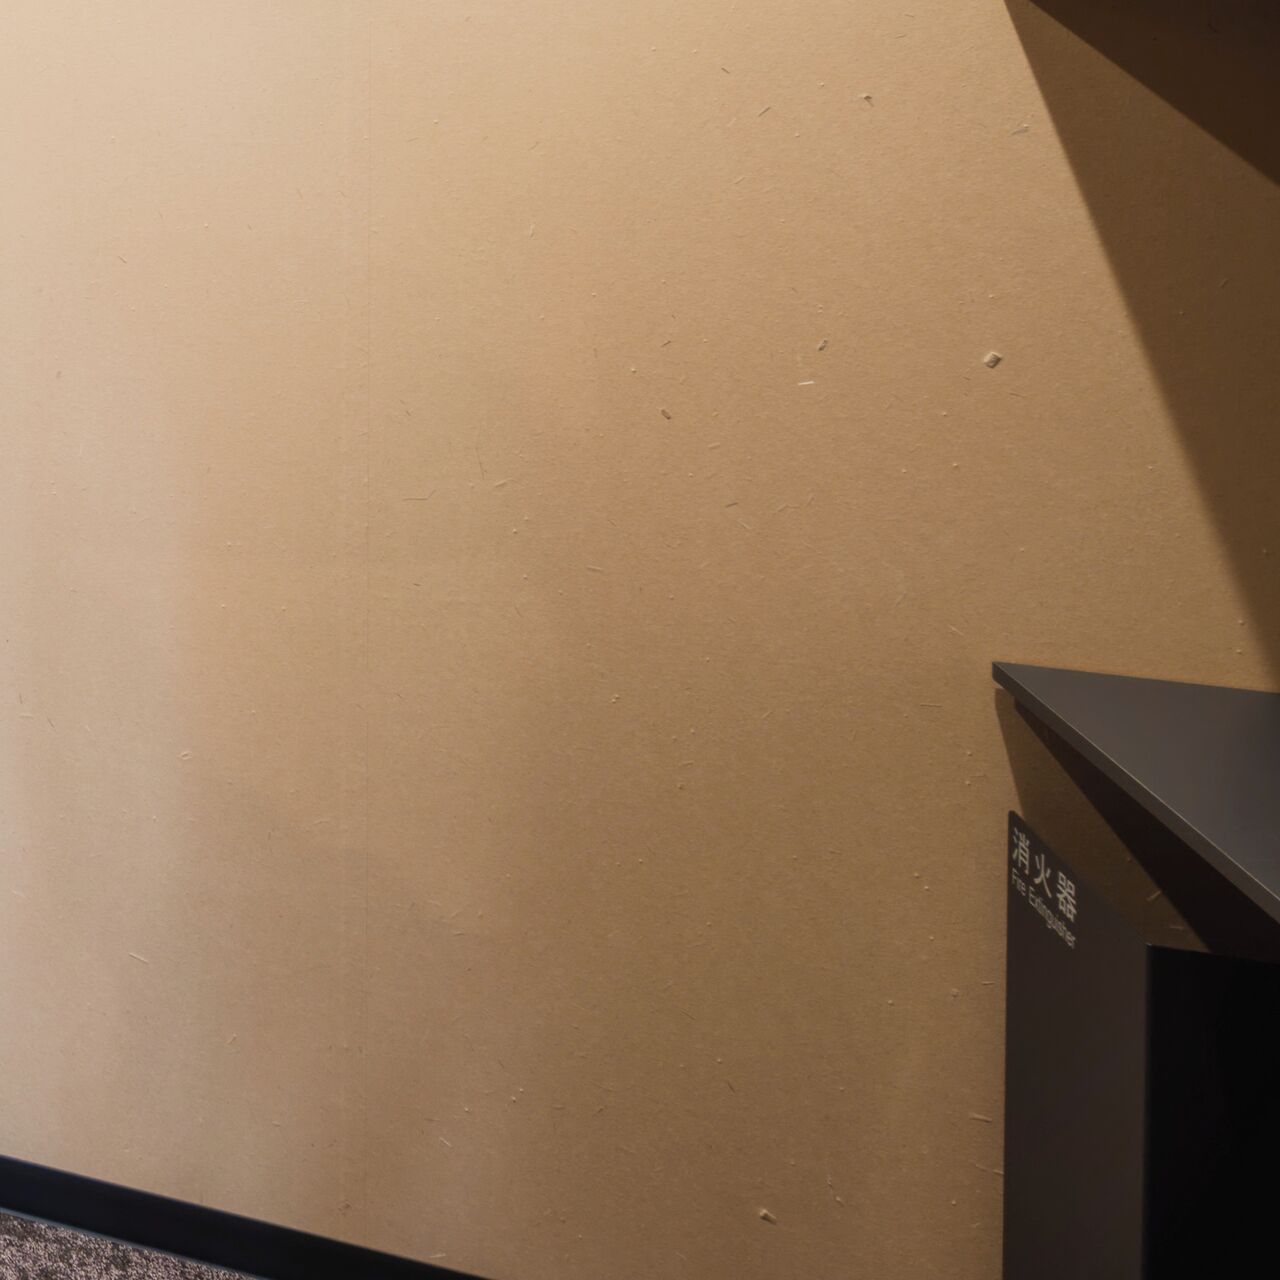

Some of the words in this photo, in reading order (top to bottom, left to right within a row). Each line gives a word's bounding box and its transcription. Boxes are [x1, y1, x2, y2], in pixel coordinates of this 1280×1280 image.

[1011, 827, 1078, 923] 消火器
[1011, 867, 1027, 897] Fire
[1028, 886, 1077, 950] Extinguisher
